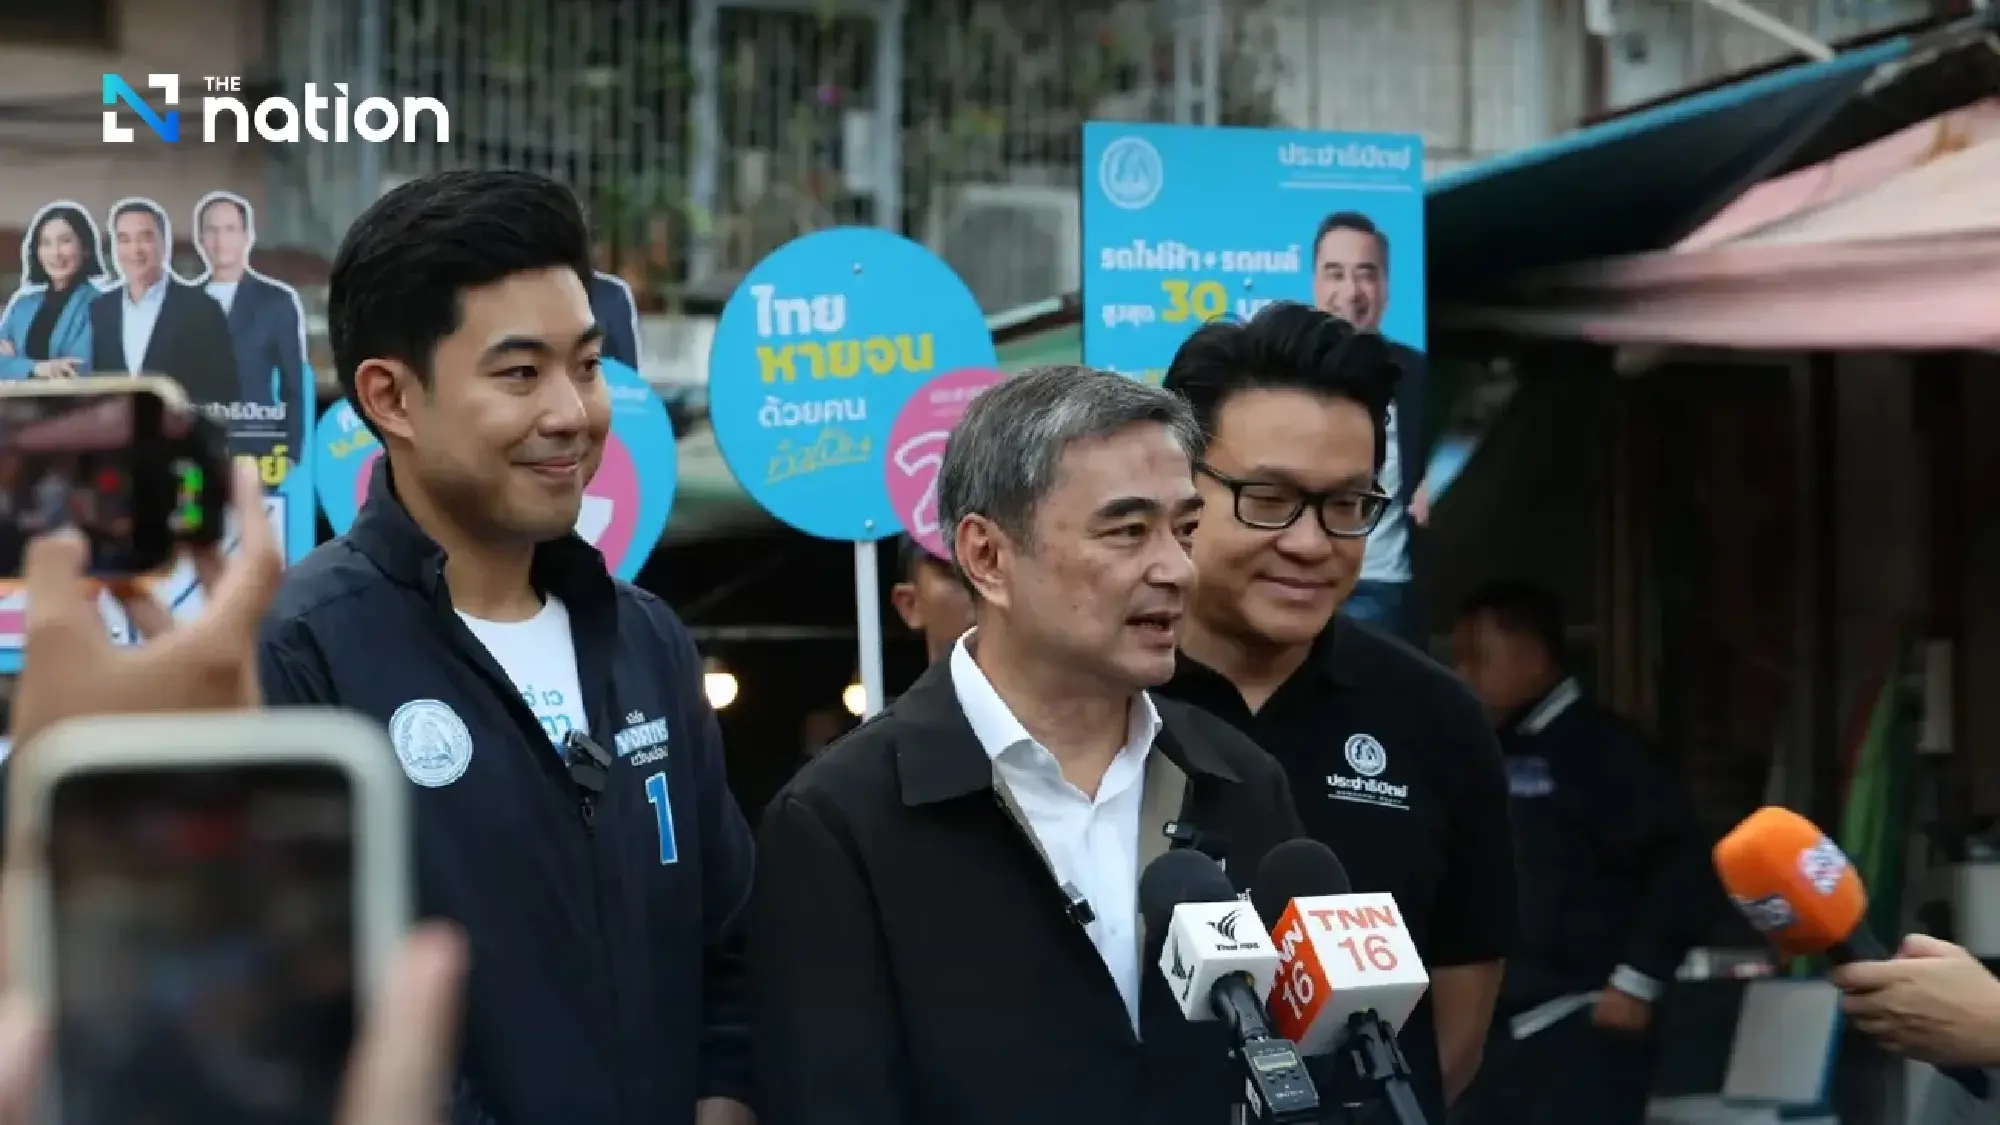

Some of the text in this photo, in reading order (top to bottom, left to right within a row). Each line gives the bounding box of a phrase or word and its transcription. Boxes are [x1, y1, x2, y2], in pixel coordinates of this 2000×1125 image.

[750, 283, 848, 338] ไทย
[1161, 279, 1229, 323] 30
[757, 332, 934, 384] หายจน
[759, 395, 867, 428] ด้วยคน
[645, 771, 678, 865] 1
[1308, 905, 1397, 931] TNN
[1337, 933, 1399, 972] 16
[1282, 960, 1314, 1020] 16
